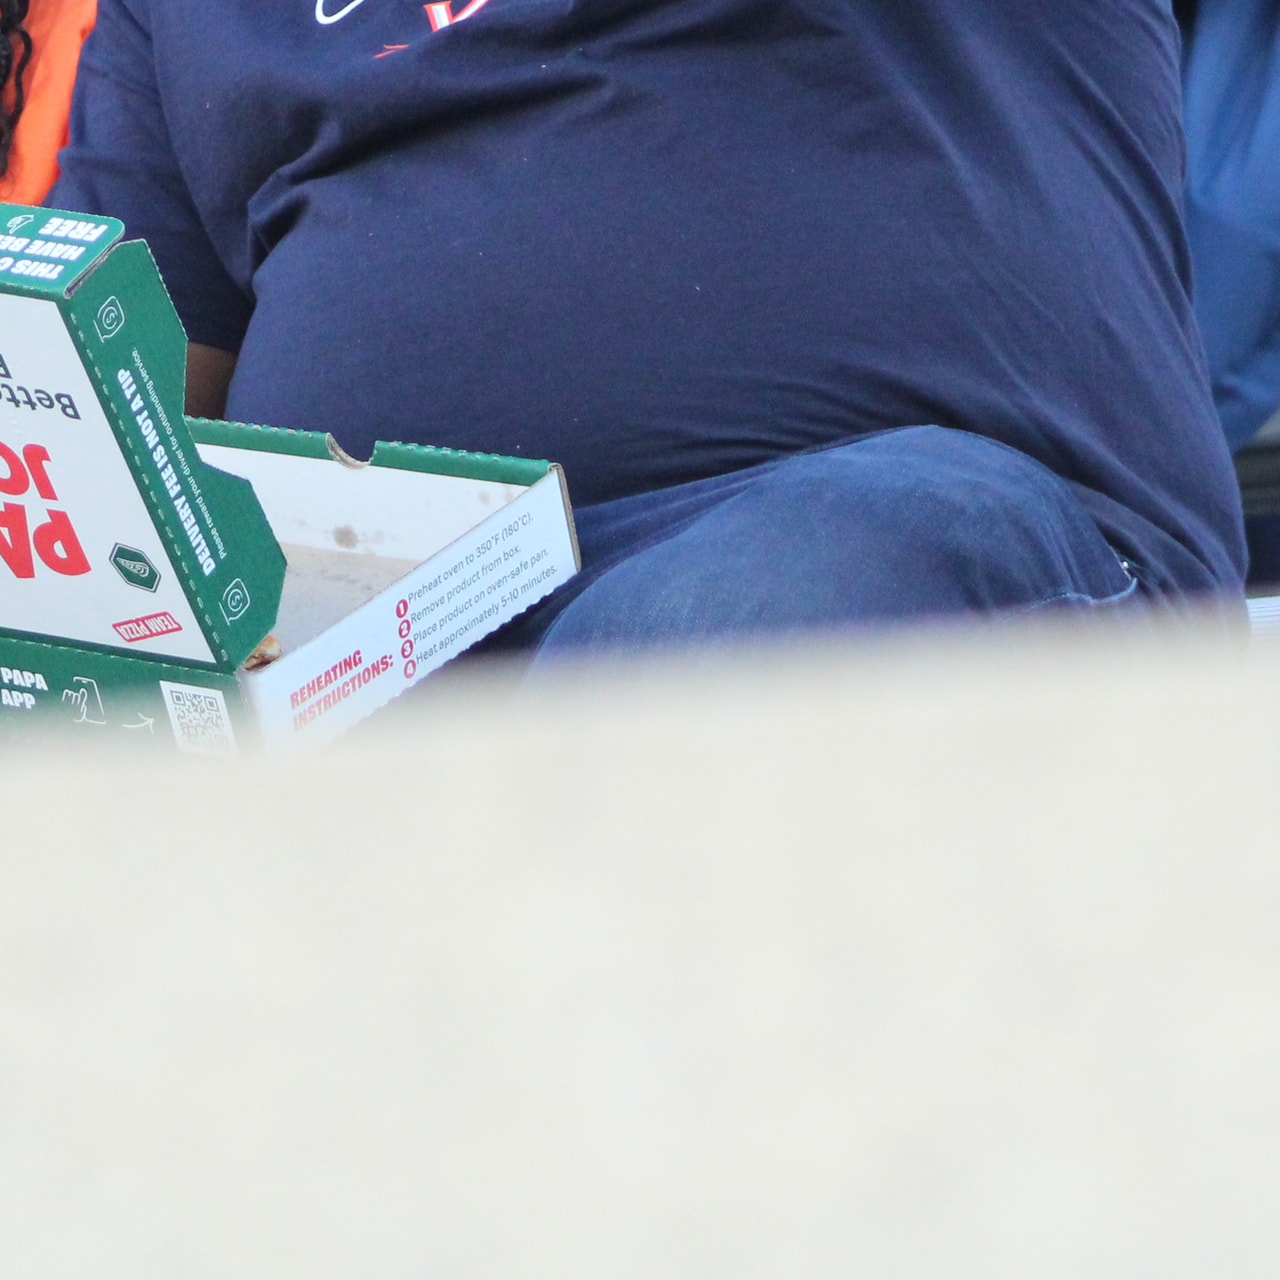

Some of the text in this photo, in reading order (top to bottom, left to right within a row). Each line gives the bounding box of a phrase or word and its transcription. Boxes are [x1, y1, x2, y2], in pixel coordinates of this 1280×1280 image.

[23, 239, 86, 261] HAVE
[38, 217, 108, 242] FREE
[11, 259, 65, 279] THIS
[117, 368, 217, 578] DELIVERY FEE IS NOT A TIP
[130, 346, 227, 560] Please reward your driver for outstanding service.
[407, 574, 442, 604] Preheat
[443, 561, 464, 580] oven
[465, 553, 475, 566] to
[410, 597, 446, 624] Remove
[447, 574, 481, 603] product
[481, 556, 502, 577] from
[503, 544, 521, 561] box.
[413, 623, 438, 644] Place
[439, 599, 473, 630] product
[474, 589, 486, 604] on
[487, 560, 529, 595] oven-safe
[530, 548, 549, 568] pan.
[116, 614, 179, 639] TEAM PIZZA
[415, 644, 438, 665] Heat
[439, 602, 500, 650] approximately
[501, 587, 520, 607] 5-10
[520, 564, 558, 593] minutes.
[1, 666, 49, 691] PAPA
[2, 688, 36, 710] APP
[290, 649, 363, 709] REHEATING
[293, 654, 394, 731] INSTRUCTIONS:
